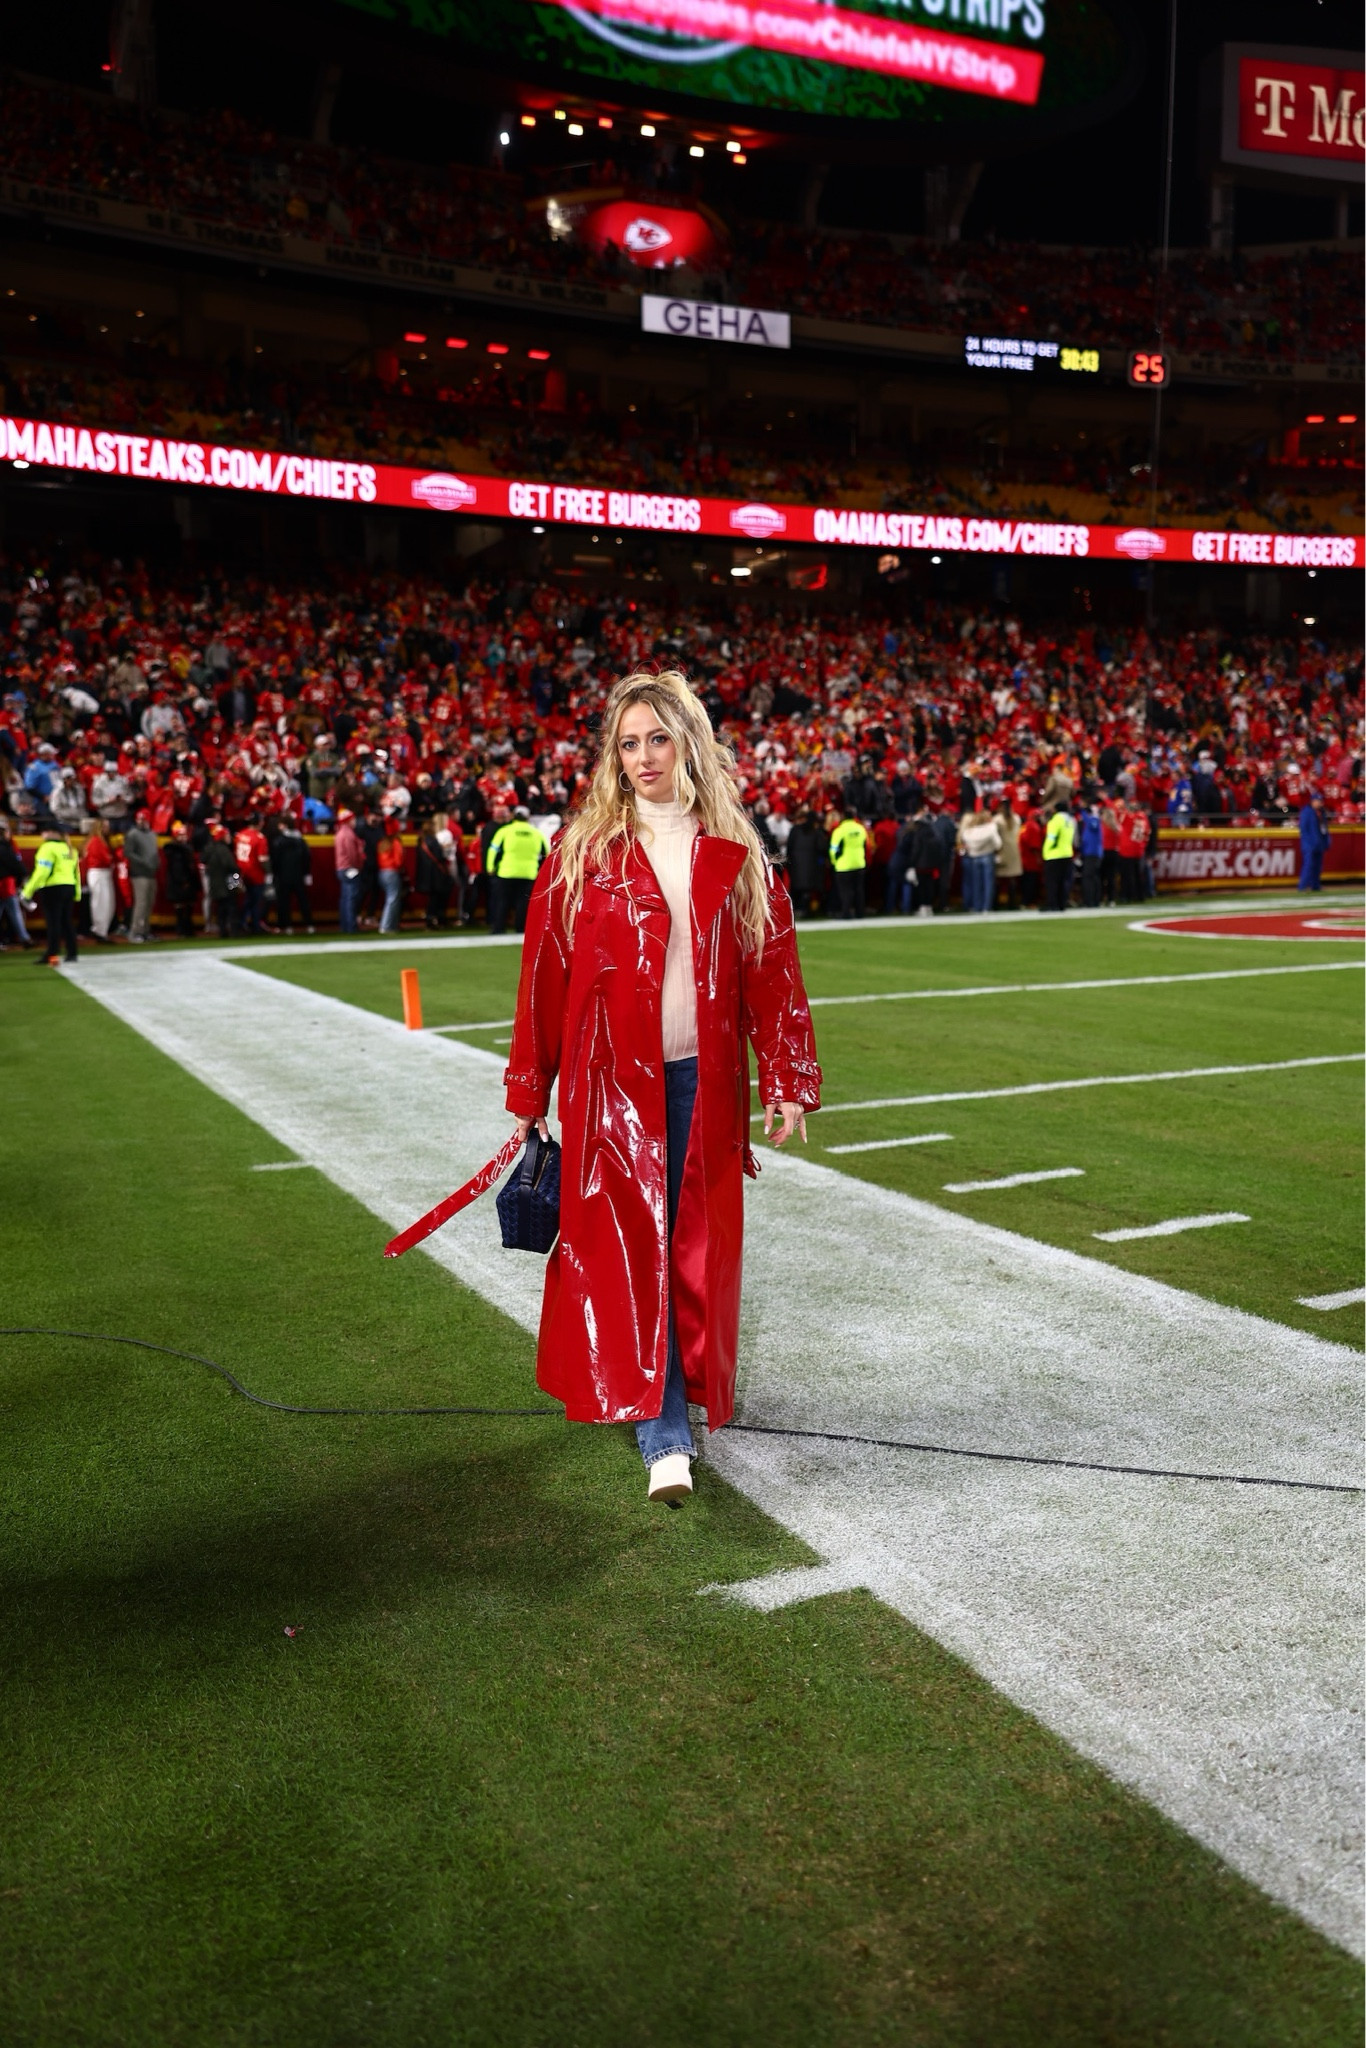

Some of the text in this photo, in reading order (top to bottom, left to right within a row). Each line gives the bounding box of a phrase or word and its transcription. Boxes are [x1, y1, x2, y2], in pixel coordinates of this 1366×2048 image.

[664, 301, 769, 344] GEHA
[965, 352, 1034, 371] YOUR FREE
[982, 337, 1020, 355] HOURS
[1021, 340, 1037, 356] TO
[1037, 342, 1058, 358] GET
[1132, 353, 1165, 384] 25
[508, 482, 551, 518] GET
[553, 487, 606, 523] FREE
[608, 492, 701, 532] BURGERS
[813, 508, 1090, 556] OMAHASTEAKS.COM/CHIEFS
[1192, 531, 1227, 561] GET
[1228, 532, 1272, 564] FREE
[1273, 534, 1356, 566] BURGERS
